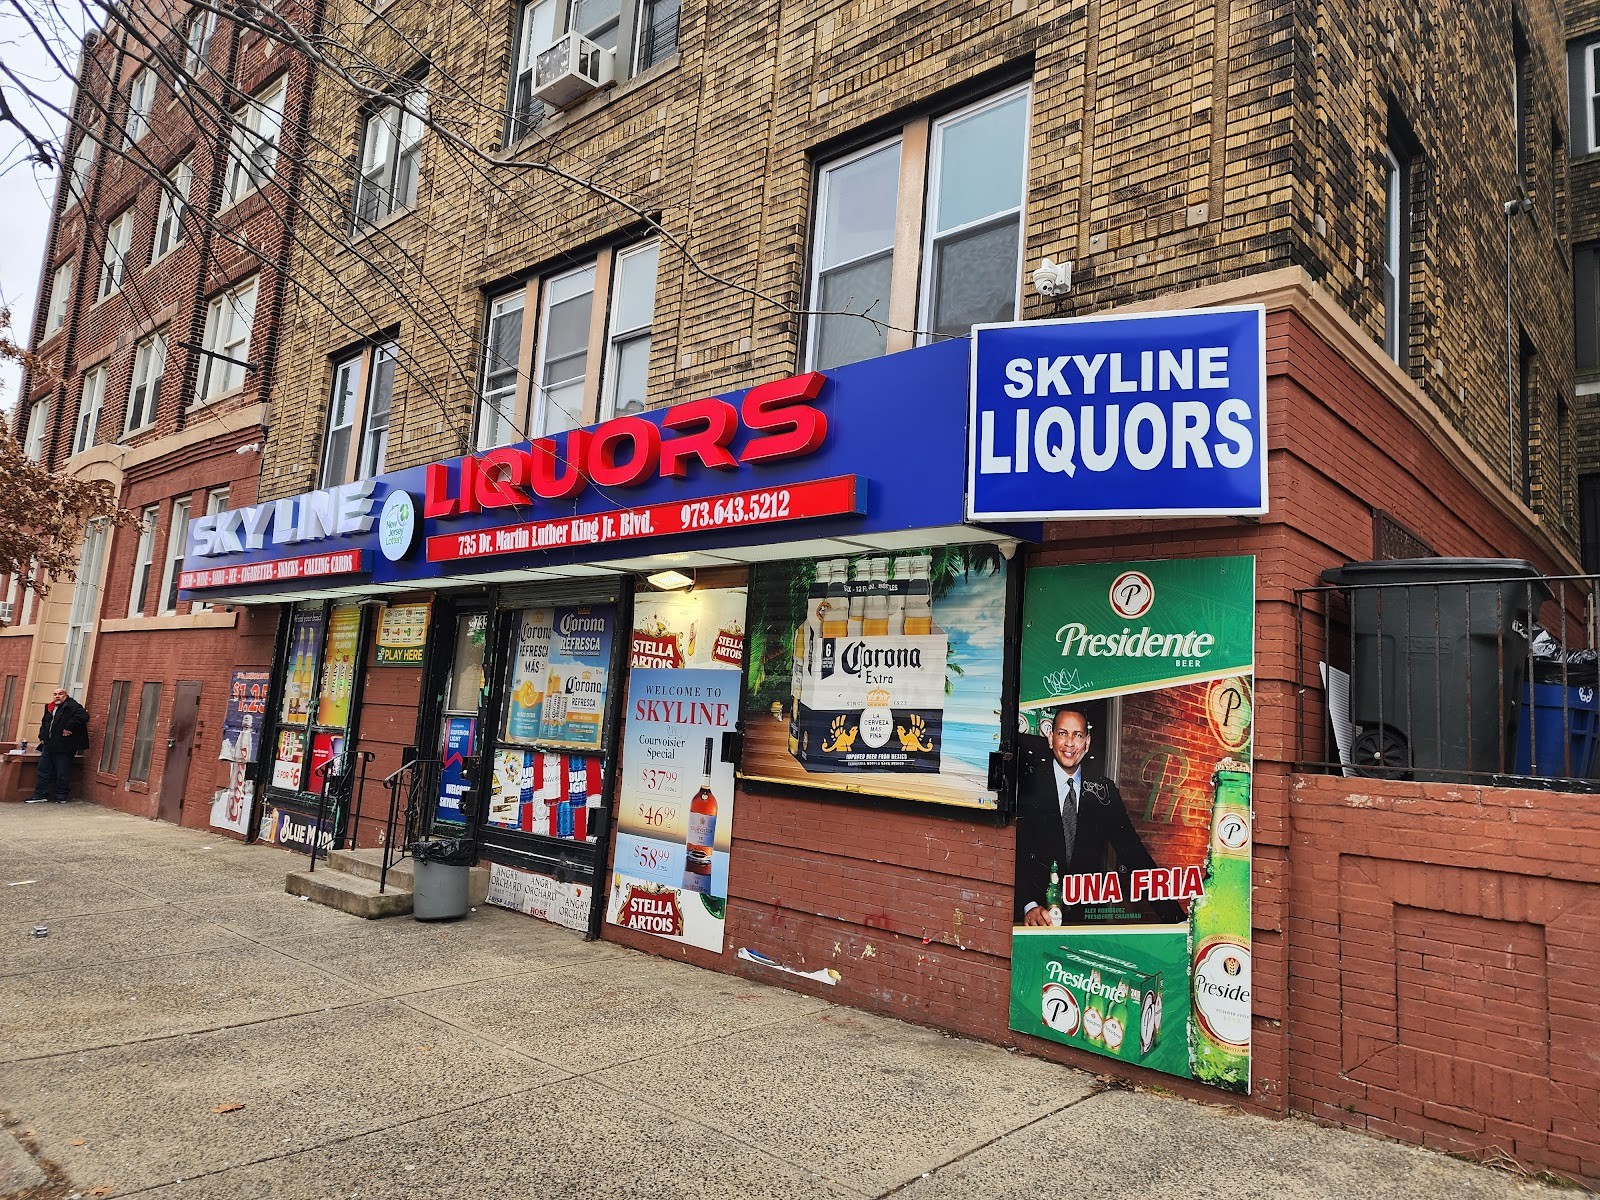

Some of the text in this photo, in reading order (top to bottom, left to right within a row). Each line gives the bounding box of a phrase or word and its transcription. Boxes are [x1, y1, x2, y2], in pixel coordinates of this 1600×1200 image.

[1004, 346, 1230, 399] SKYLINE
[424, 371, 828, 519] LIQUORS
[980, 398, 1253, 478] LIQUORS
[192, 480, 377, 556] SKYLINE
[386, 521, 397, 529] New
[458, 490, 791, 556] 735 Dr. Martin Luther King Jr. Blvd. 973.643.5212
[388, 528, 403, 537] Jersey
[386, 536, 403, 545] Lottery
[304, 556, 330, 575] CALLING
[331, 554, 353, 573] CARDS
[560, 613, 606, 637] Corona
[560, 637, 601, 651] REFRESCA
[718, 636, 744, 650] STELLA
[1056, 622, 1215, 658] Presidente
[385, 649, 403, 660] PLAY
[404, 649, 424, 661] HERE
[633, 640, 674, 658] STELLA
[715, 646, 742, 660] ARTOIS
[825, 643, 832, 657] 6
[631, 654, 674, 668] ARTOIS
[841, 640, 922, 678] Corona
[1175, 659, 1201, 667] BEER
[865, 670, 894, 684] Extra
[565, 676, 602, 696] Corona
[646, 685, 722, 698] WELCOME TO
[571, 697, 596, 707] REFRESCA
[635, 699, 729, 727] SKYLINE
[448, 741, 459, 749] BEER
[639, 734, 686, 748] Courvoisier
[646, 747, 675, 760] Special
[280, 815, 306, 844] BLUE
[496, 867, 518, 880] ANGRY
[491, 876, 522, 892] ORCHARD
[531, 877, 552, 889] ANGRY
[1062, 865, 1205, 906] UNA FRIA
[524, 886, 557, 901] ORCHARD
[565, 897, 589, 911] ANGRY
[630, 897, 673, 916] STELLA
[558, 907, 589, 922] ORCHAR
[628, 914, 673, 933] ARTOIS
[1046, 961, 1126, 1004] Presidente
[1195, 974, 1250, 1003] Preside
